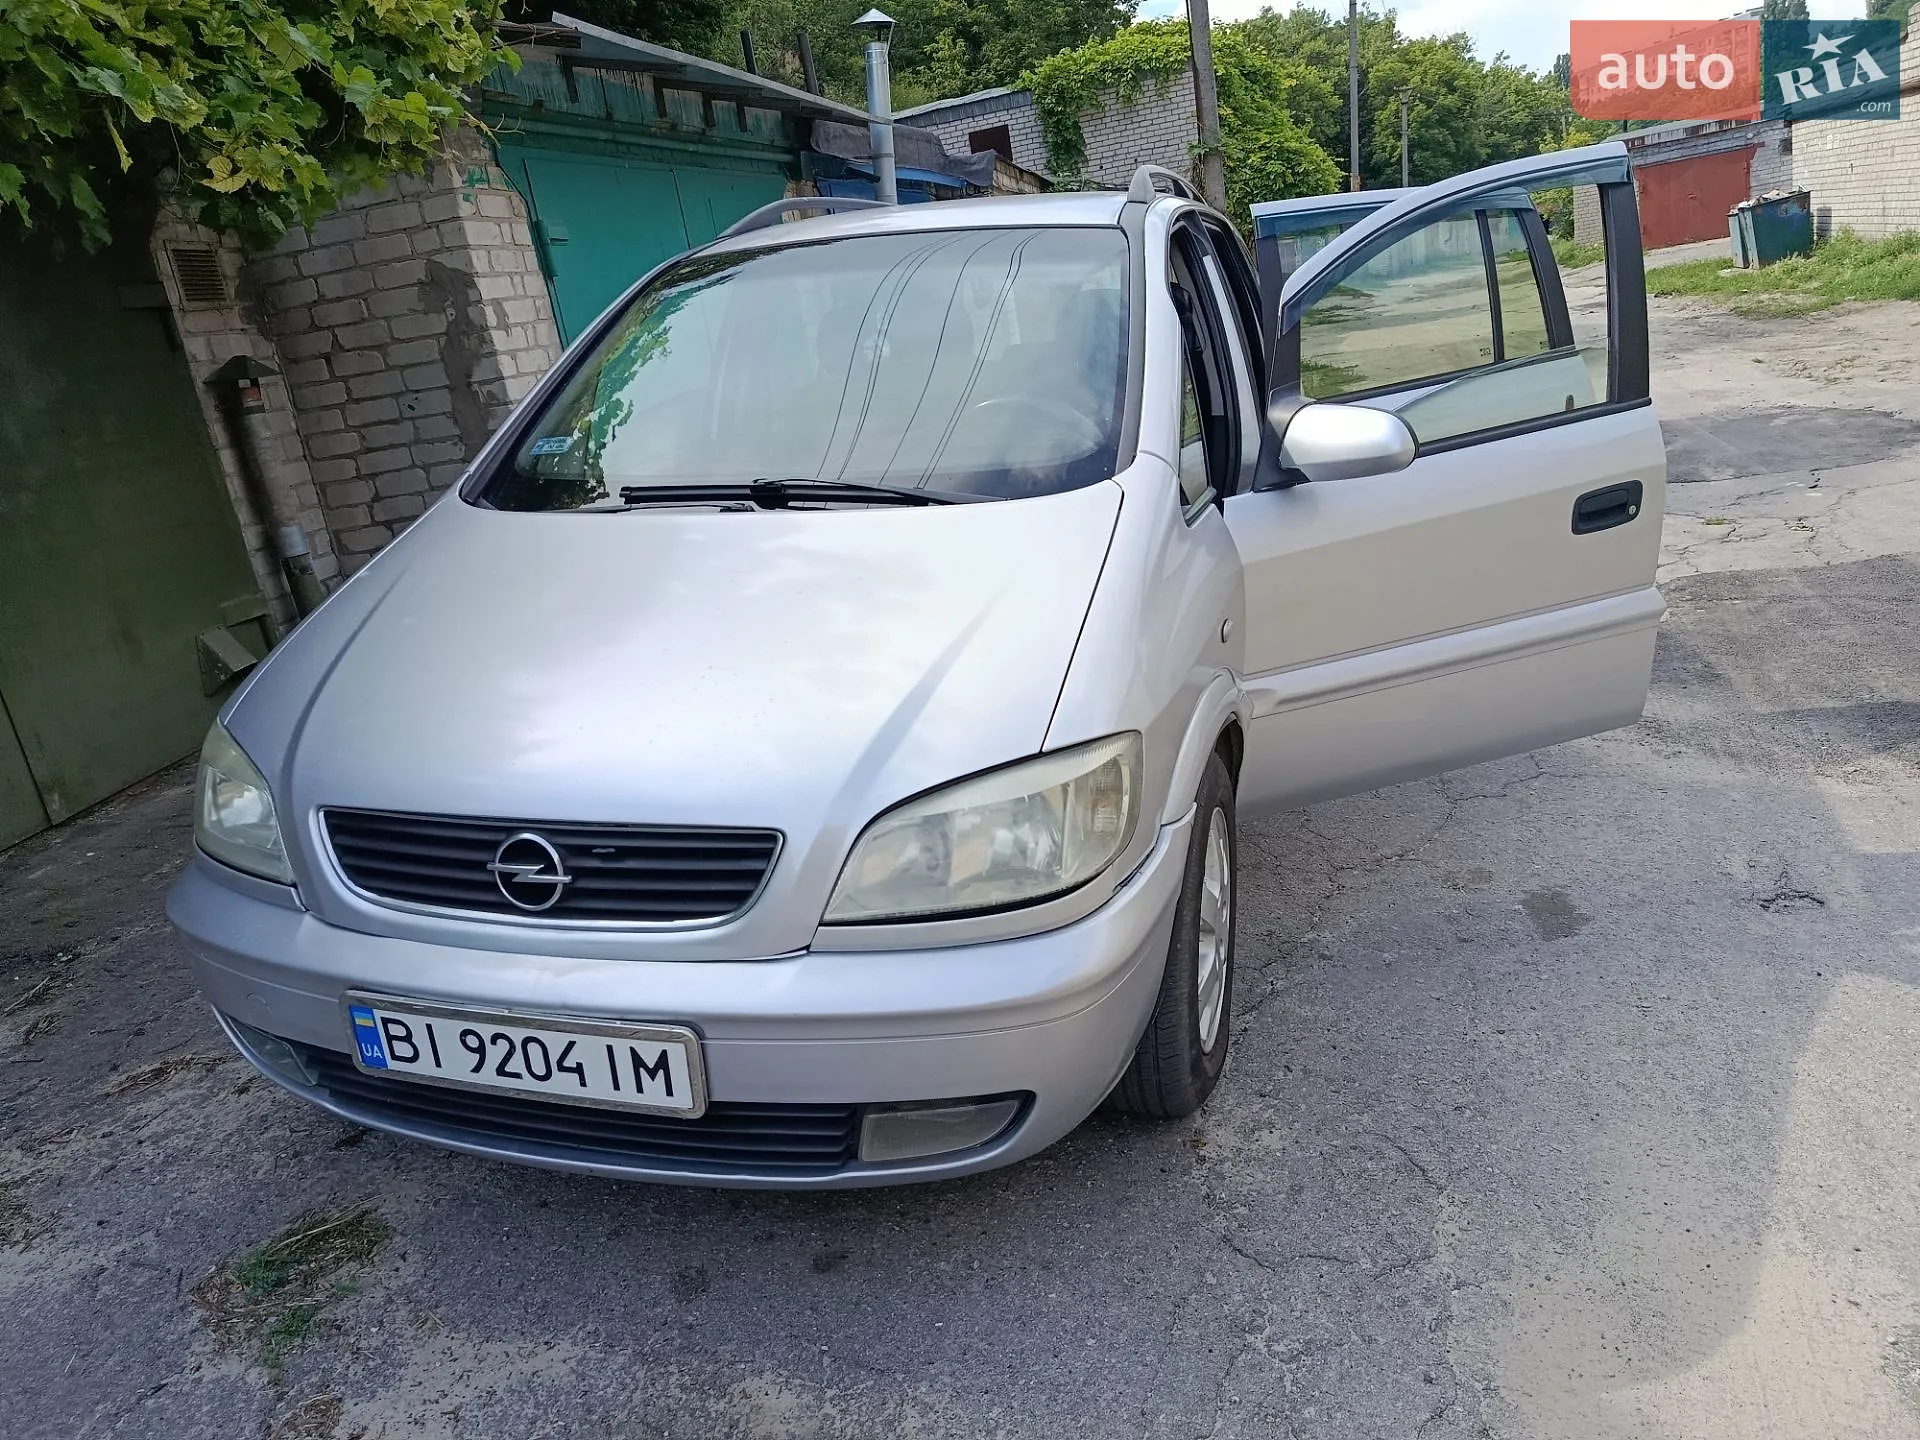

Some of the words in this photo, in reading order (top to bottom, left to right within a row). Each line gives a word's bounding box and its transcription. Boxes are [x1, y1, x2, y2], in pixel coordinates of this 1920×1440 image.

[361, 1043, 383, 1059] UA
[380, 1016, 442, 1068] BI
[459, 1028, 588, 1088] 9204
[606, 1044, 674, 1097] IM
